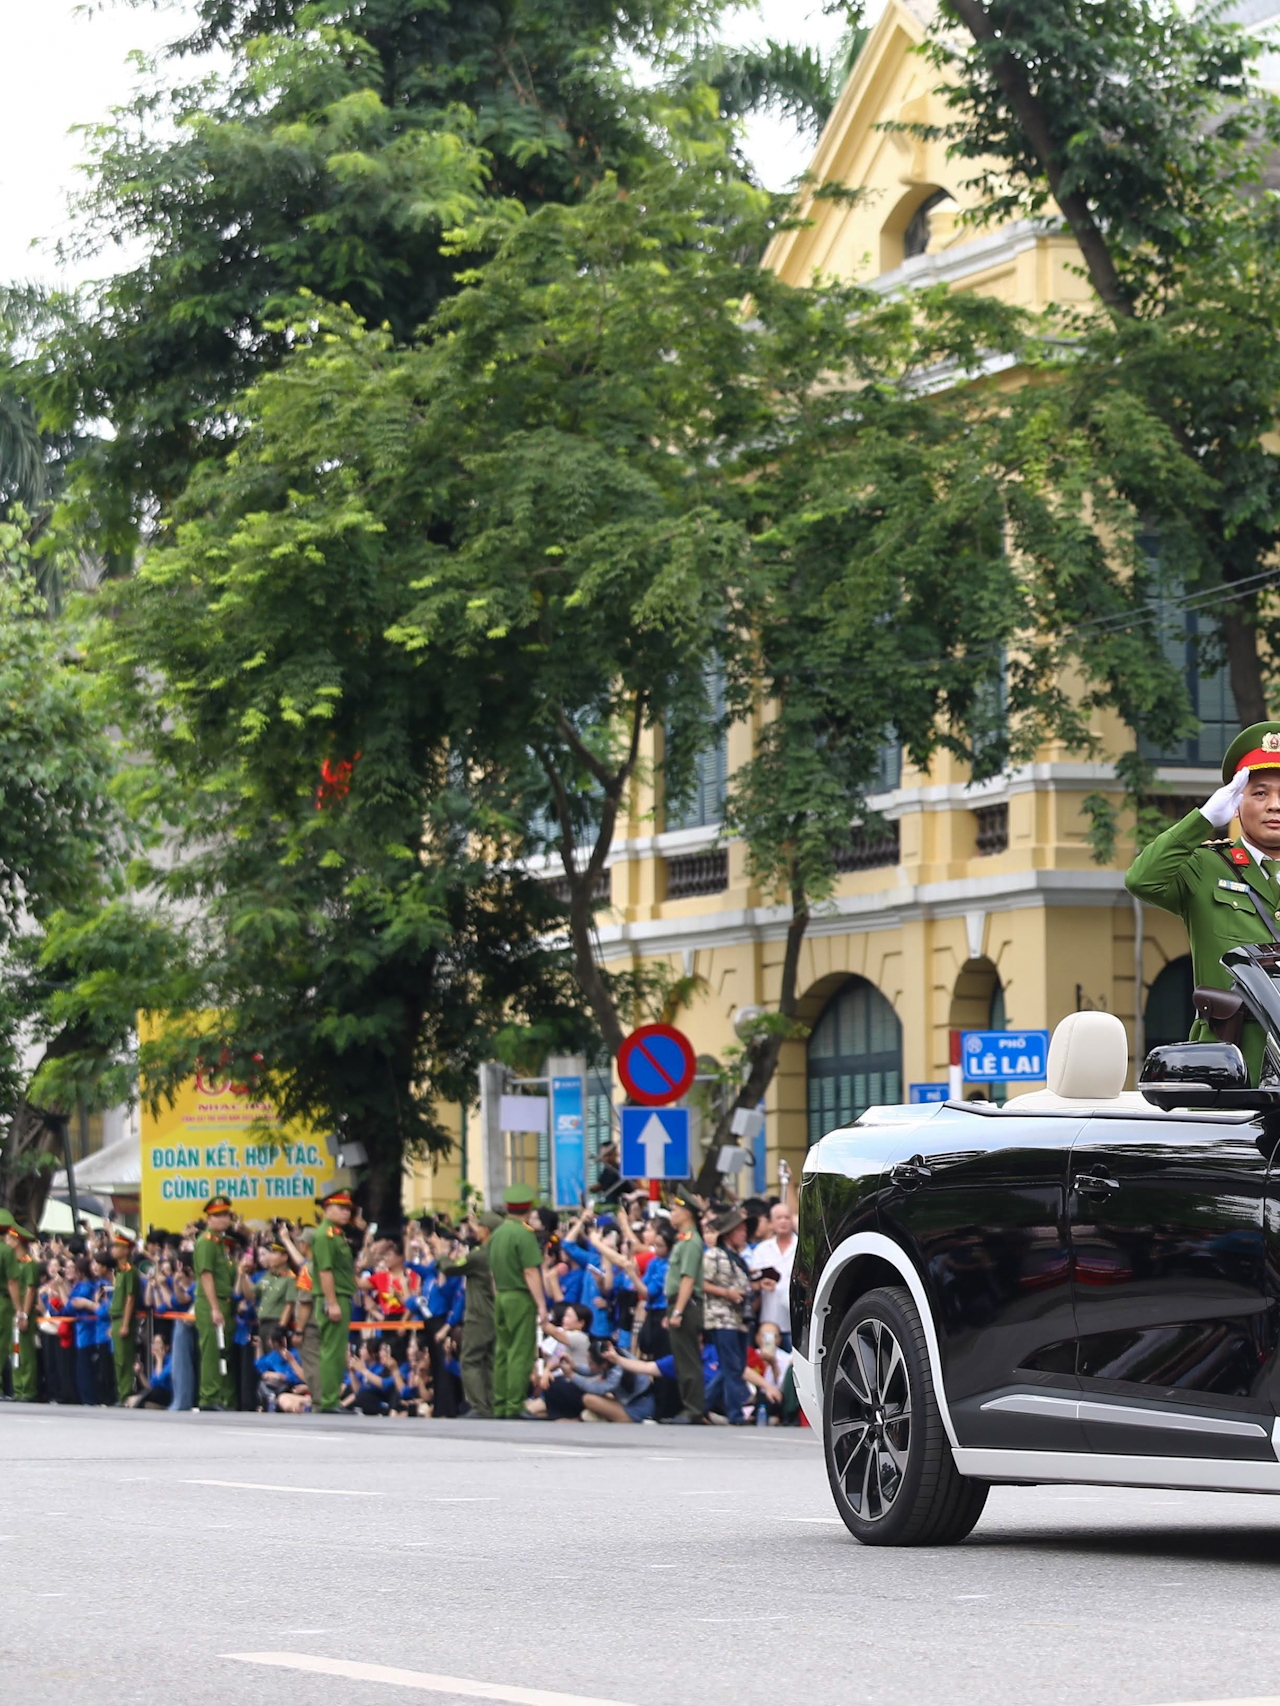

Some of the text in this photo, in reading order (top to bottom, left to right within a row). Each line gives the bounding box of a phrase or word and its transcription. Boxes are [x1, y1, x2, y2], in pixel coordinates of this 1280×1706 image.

[998, 1036, 1026, 1049] PHỐ
[969, 1053, 1040, 1075] LÊ LAI
[152, 1144, 199, 1169] ĐOÀN
[206, 1140, 240, 1169] KẾT,
[286, 1142, 324, 1168] TÁC,
[162, 1169, 315, 1199] CÙNG PHÁT TRIỂN
